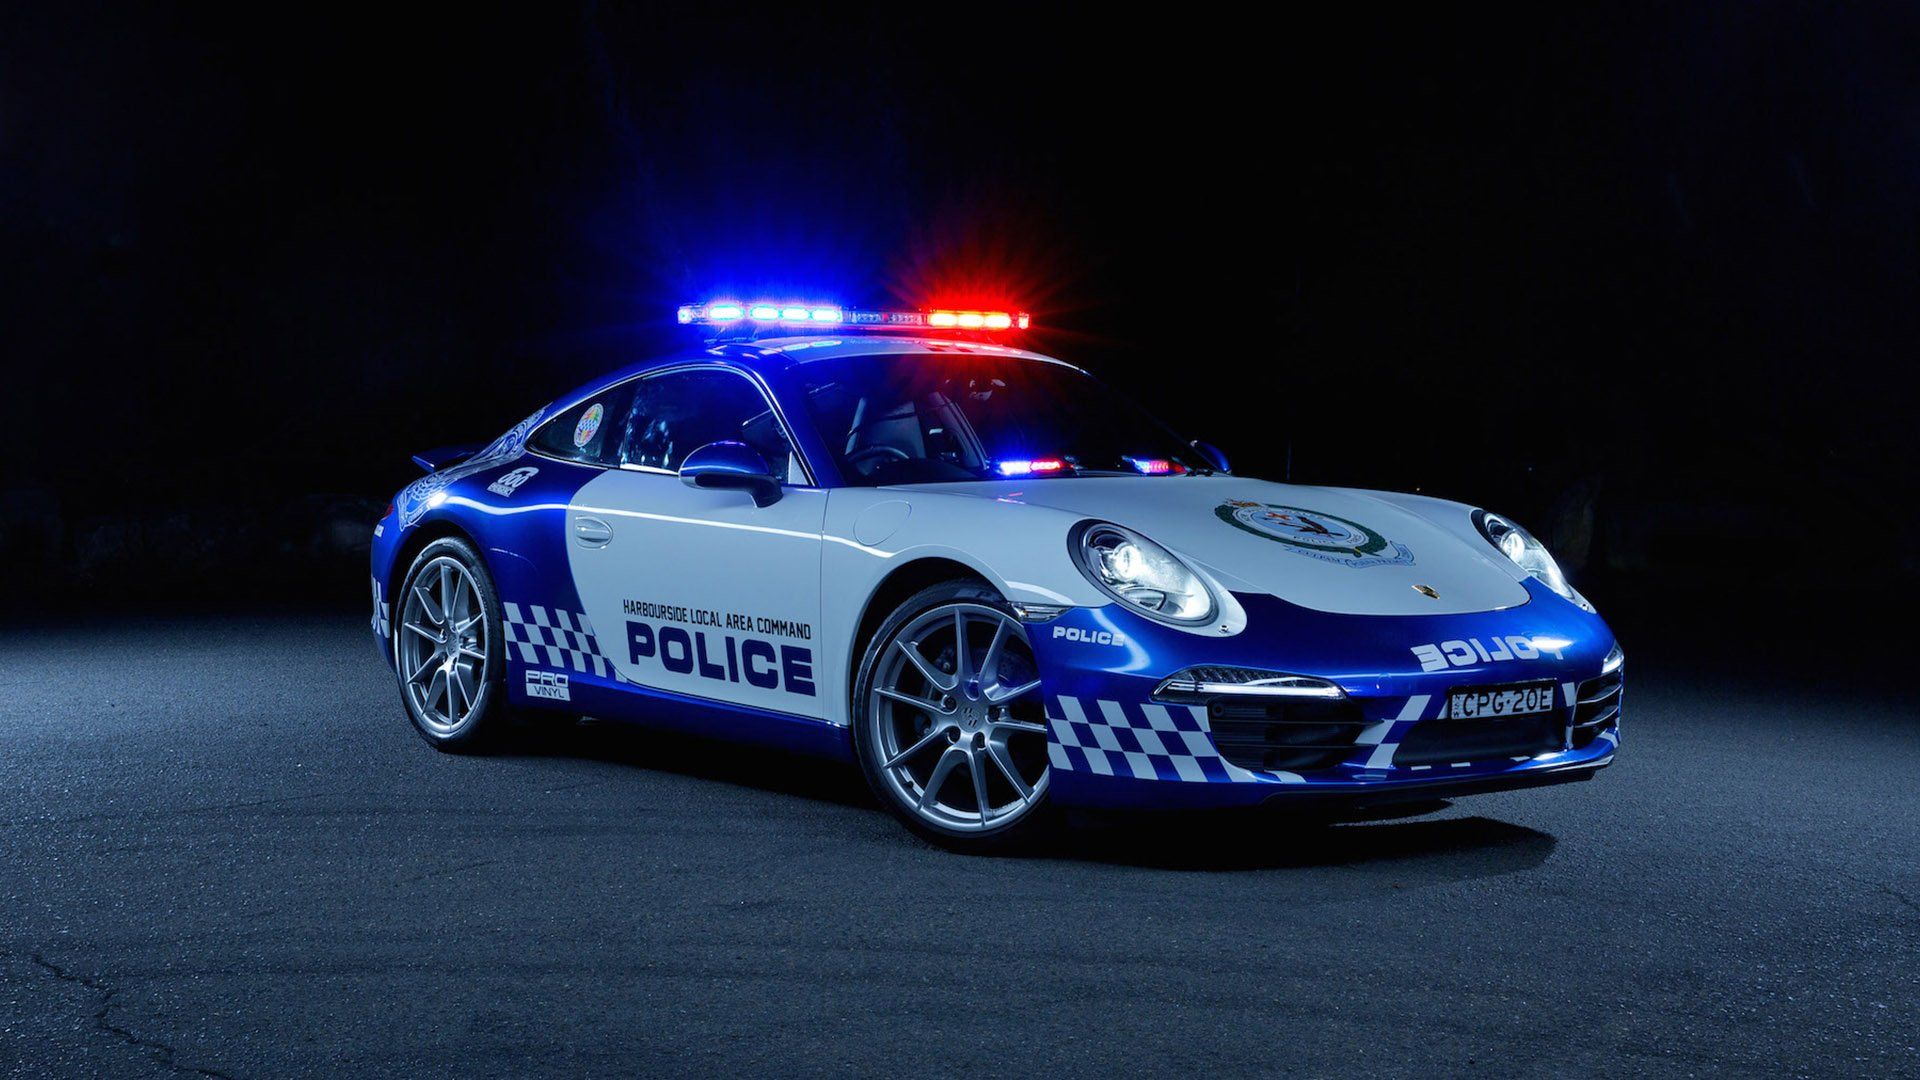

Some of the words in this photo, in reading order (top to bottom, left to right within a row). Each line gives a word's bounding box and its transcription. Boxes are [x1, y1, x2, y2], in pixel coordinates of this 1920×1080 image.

[623, 599, 688, 623] HARBOURSIDE
[690, 608, 722, 628] LOCAL
[726, 613, 754, 632] AREA
[757, 617, 811, 640] COMMAND
[1053, 626, 1125, 647] POLICE
[626, 620, 816, 697] POLICE
[525, 669, 569, 688] PRO
[534, 685, 565, 699] VINYL
